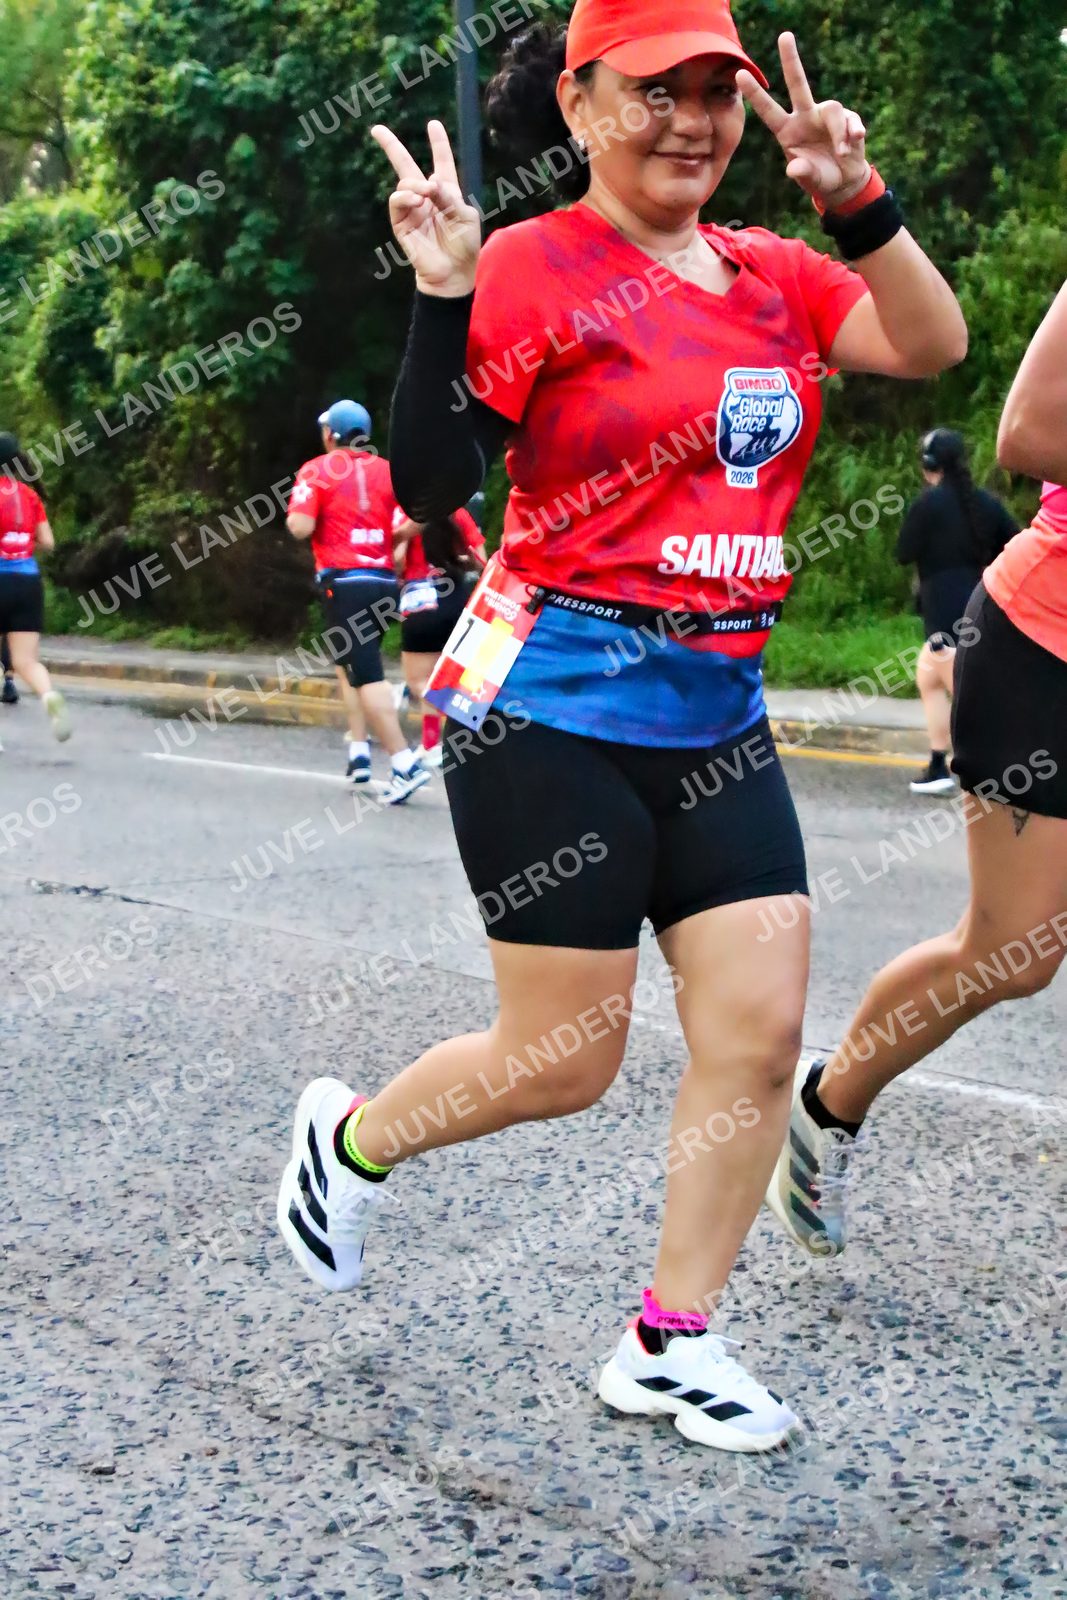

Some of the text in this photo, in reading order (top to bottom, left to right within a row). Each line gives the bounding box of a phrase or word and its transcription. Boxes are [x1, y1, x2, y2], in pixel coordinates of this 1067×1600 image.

[734, 378, 782, 390] BIMBO
[740, 397, 784, 417] Global
[730, 414, 767, 433] Race
[731, 470, 754, 484] 2026
